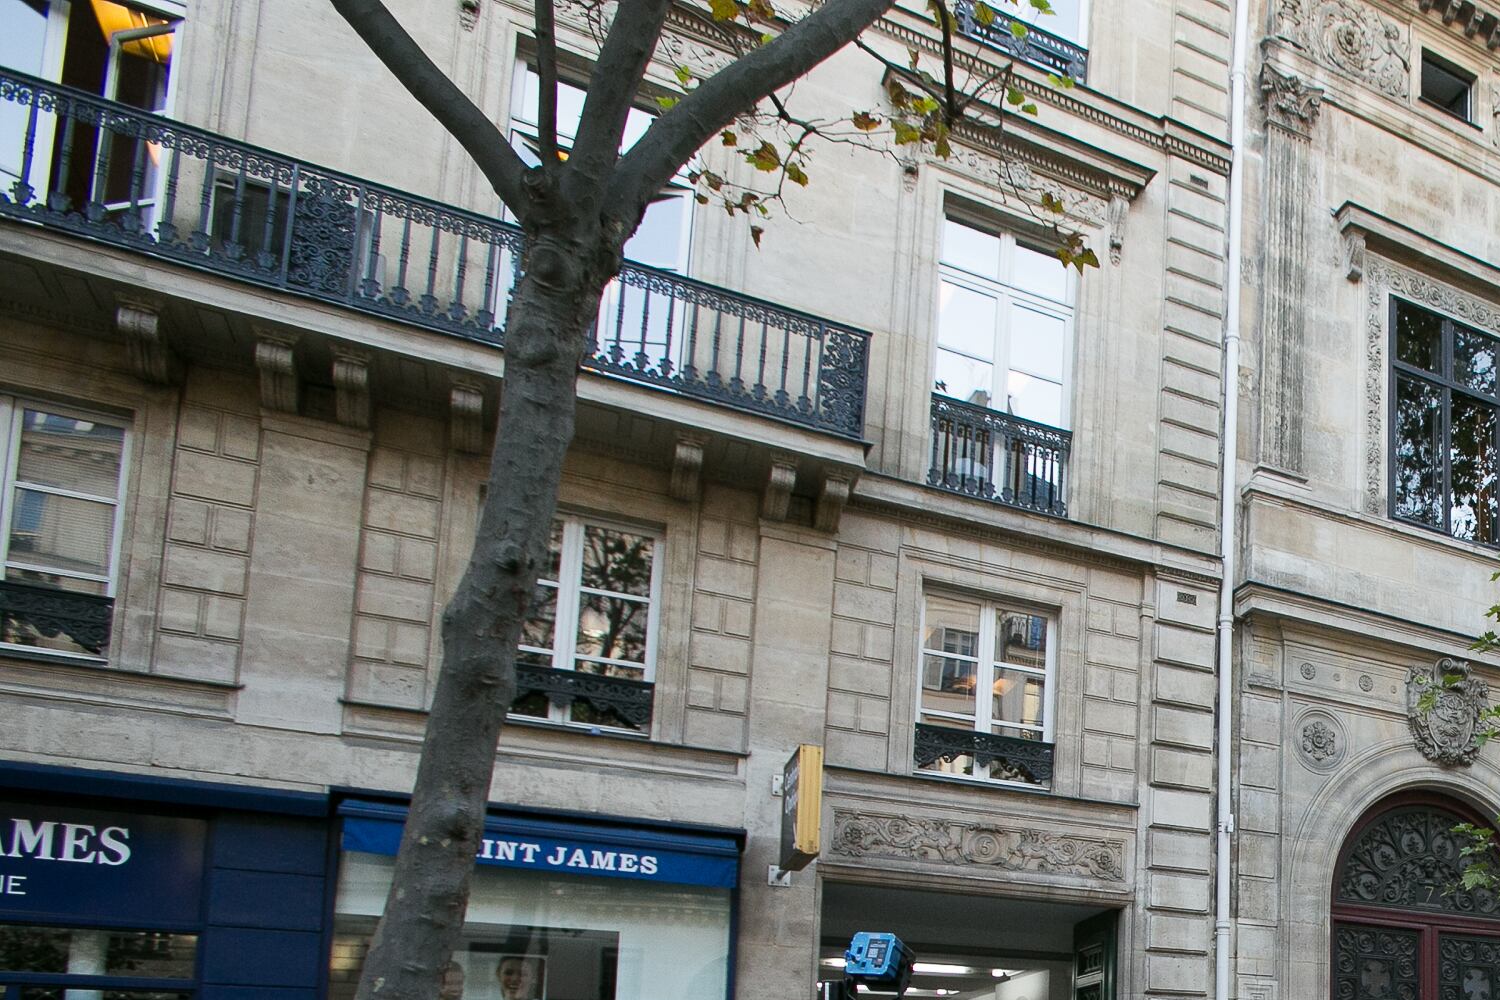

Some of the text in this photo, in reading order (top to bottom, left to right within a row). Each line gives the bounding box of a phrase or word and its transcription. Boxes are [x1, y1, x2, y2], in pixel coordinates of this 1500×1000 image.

[0, 818, 131, 866] MES
[476, 839, 658, 875] INT JAMES
[980, 840, 991, 856] 5
